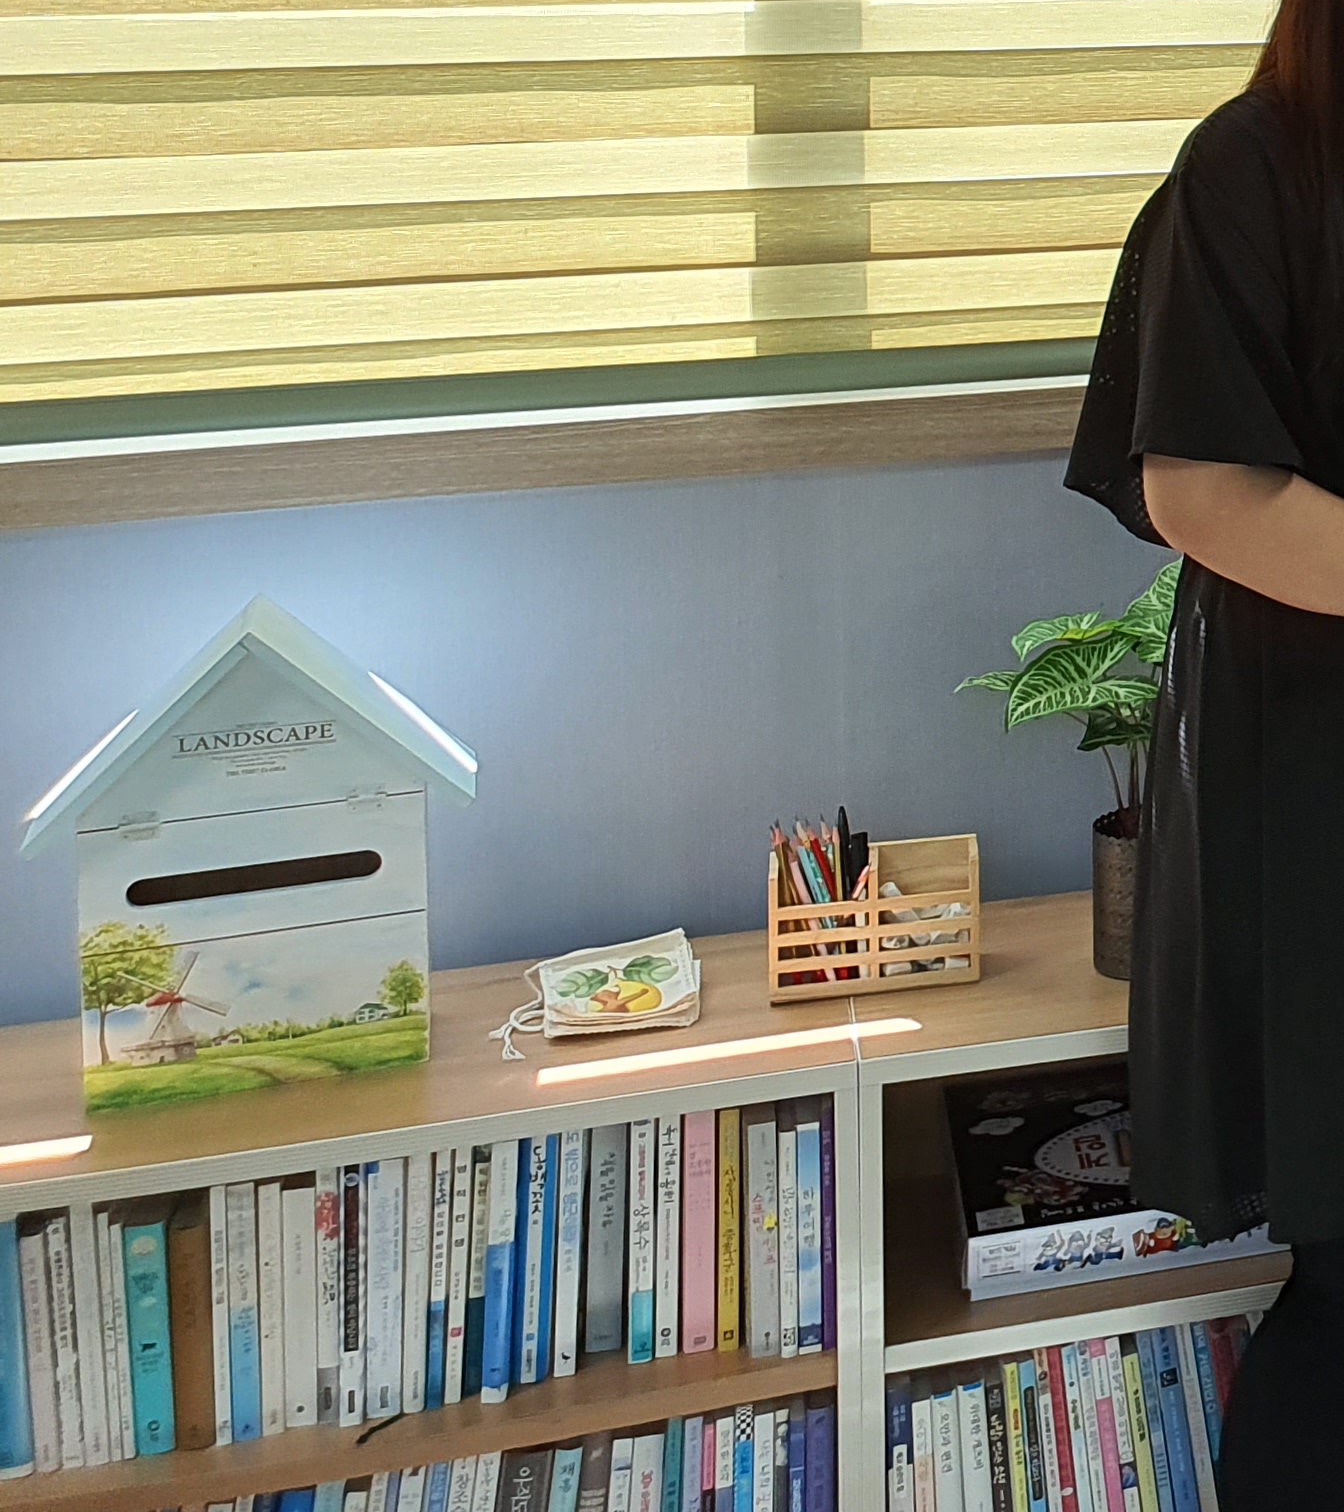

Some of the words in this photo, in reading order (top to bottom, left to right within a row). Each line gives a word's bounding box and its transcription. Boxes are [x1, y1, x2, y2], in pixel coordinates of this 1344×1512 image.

[177, 721, 336, 755] LANDSCAPE
[565, 1148, 579, 1187] 밖으로
[938, 1412, 951, 1447] 오만과
[969, 1403, 981, 1435] 위대한
[942, 1450, 953, 1474] 편견
[972, 1438, 984, 1471] 개츠비
